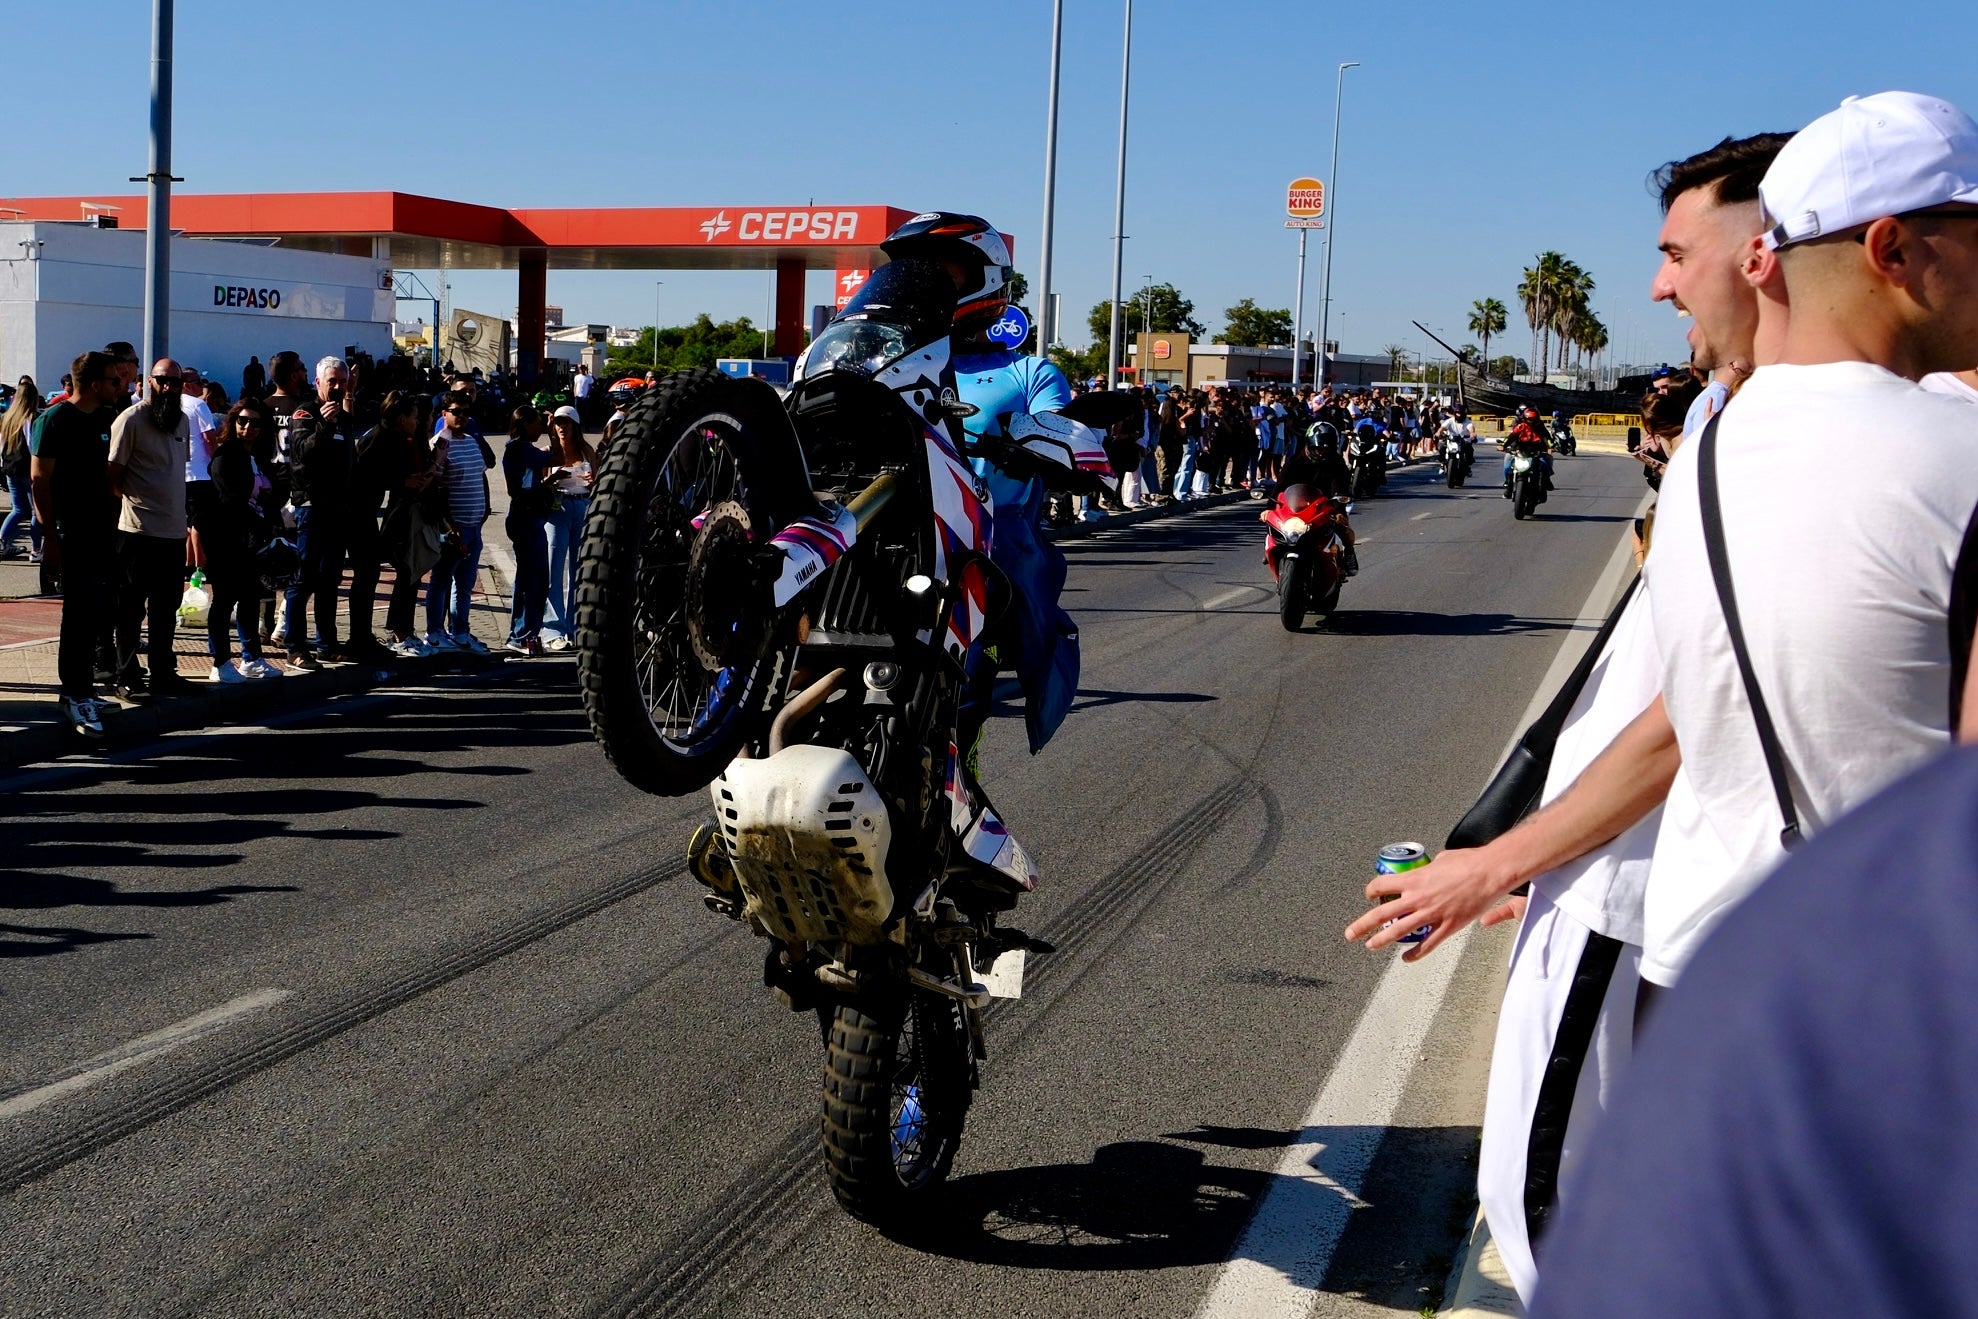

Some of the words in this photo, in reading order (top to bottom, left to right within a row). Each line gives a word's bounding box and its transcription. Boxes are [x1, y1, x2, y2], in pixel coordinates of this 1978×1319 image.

[1288, 198, 1322, 209] KING
[1289, 190, 1322, 198] BURGER
[738, 212, 859, 240] CEPSA
[214, 285, 281, 309] DEPASO
[794, 560, 818, 586] YAMAHA
